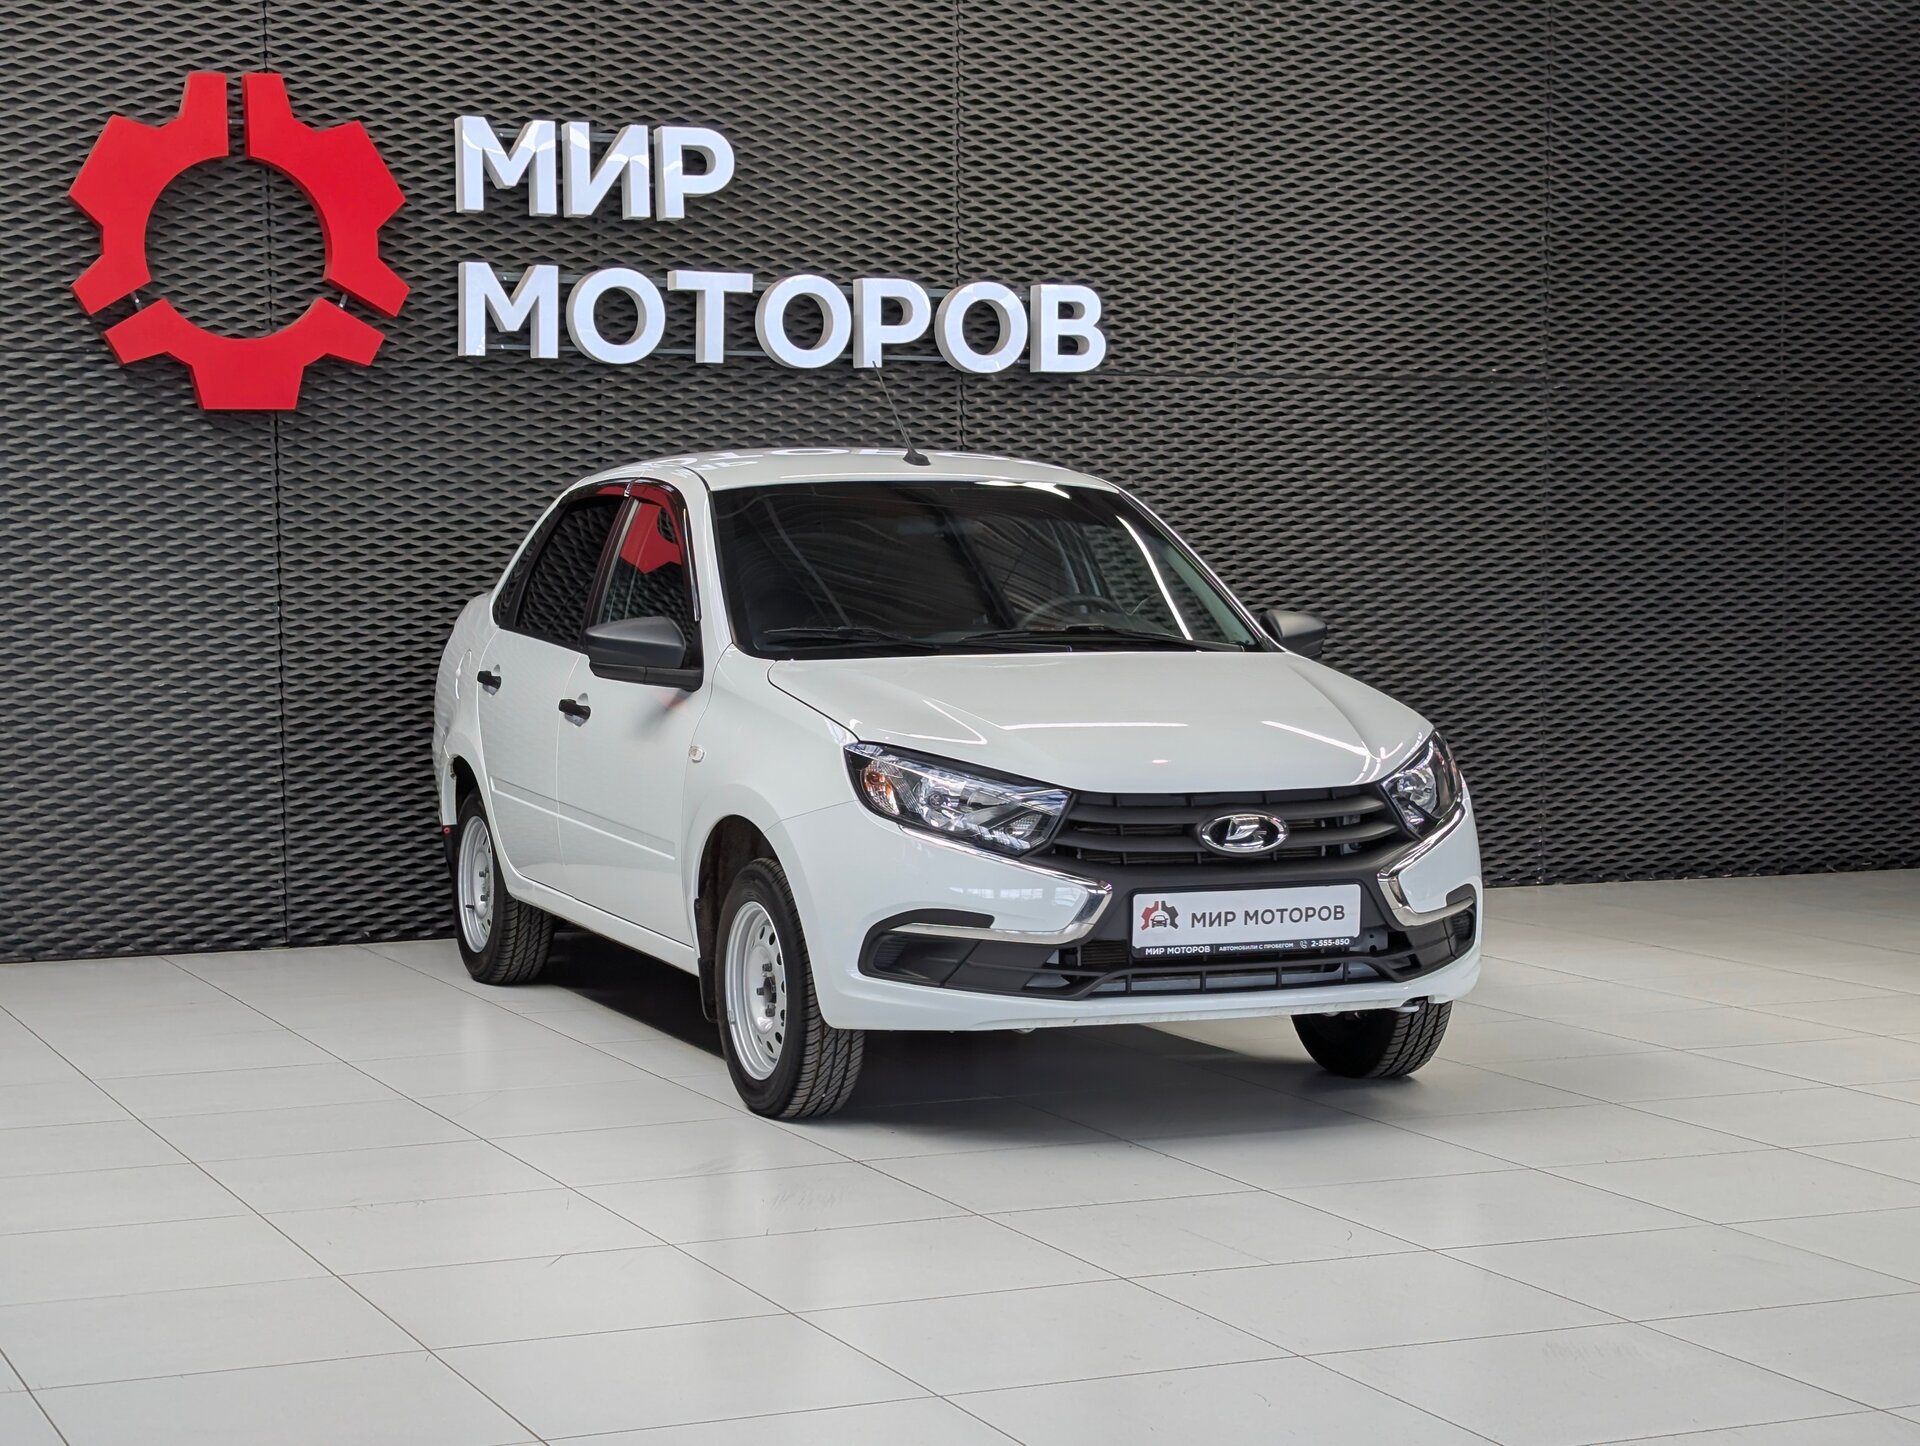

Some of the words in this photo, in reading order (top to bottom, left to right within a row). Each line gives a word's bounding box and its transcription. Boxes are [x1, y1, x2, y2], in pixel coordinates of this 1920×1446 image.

[454, 115, 735, 221] МИР
[458, 262, 1107, 374] МОТОРОВ
[1145, 947, 1165, 955] МИР
[1167, 945, 1211, 954] МОТОРОВ
[1219, 944, 1258, 952] АВТОМОБИЛИ
[1264, 942, 1294, 950] ПРОБЕГОМ
[1311, 938, 1350, 947] 2-555-850
[1191, 911, 1236, 928] МИР
[1244, 905, 1345, 926] МОТОРОВ
